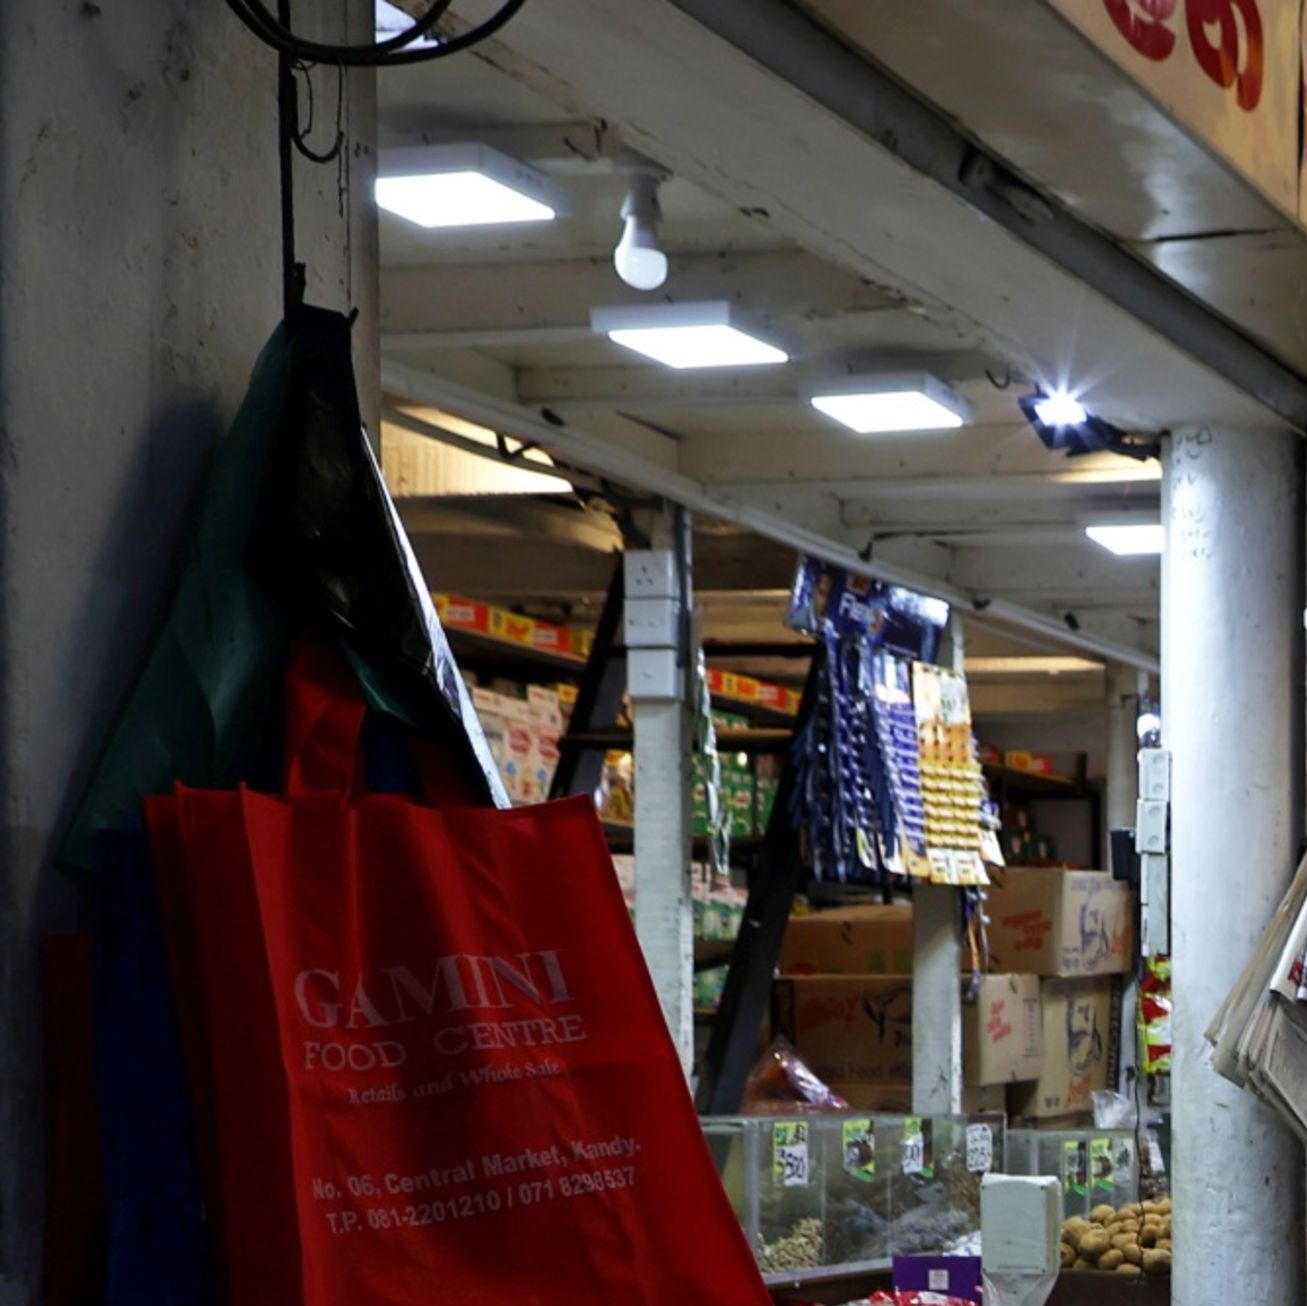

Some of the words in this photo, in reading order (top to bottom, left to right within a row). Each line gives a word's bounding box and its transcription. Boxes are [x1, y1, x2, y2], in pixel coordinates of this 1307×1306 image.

[294, 949, 576, 1030] GAMINI
[303, 1040, 407, 1072] FOOD
[433, 1014, 587, 1056] CENTRE
[413, 1076, 457, 1097] and
[460, 1065, 521, 1088] Whole
[526, 1059, 562, 1078] Sale
[312, 1178, 343, 1200] No.
[348, 1174, 383, 1198] 06,
[385, 1157, 476, 1195] Central
[482, 1145, 569, 1176] Market,
[570, 1135, 642, 1164] Kandy.
[326, 1210, 363, 1234] T.P.
[368, 1190, 501, 1230] 081-2201210
[519, 1178, 553, 1205] 071
[559, 1166, 636, 1197] 8298537
